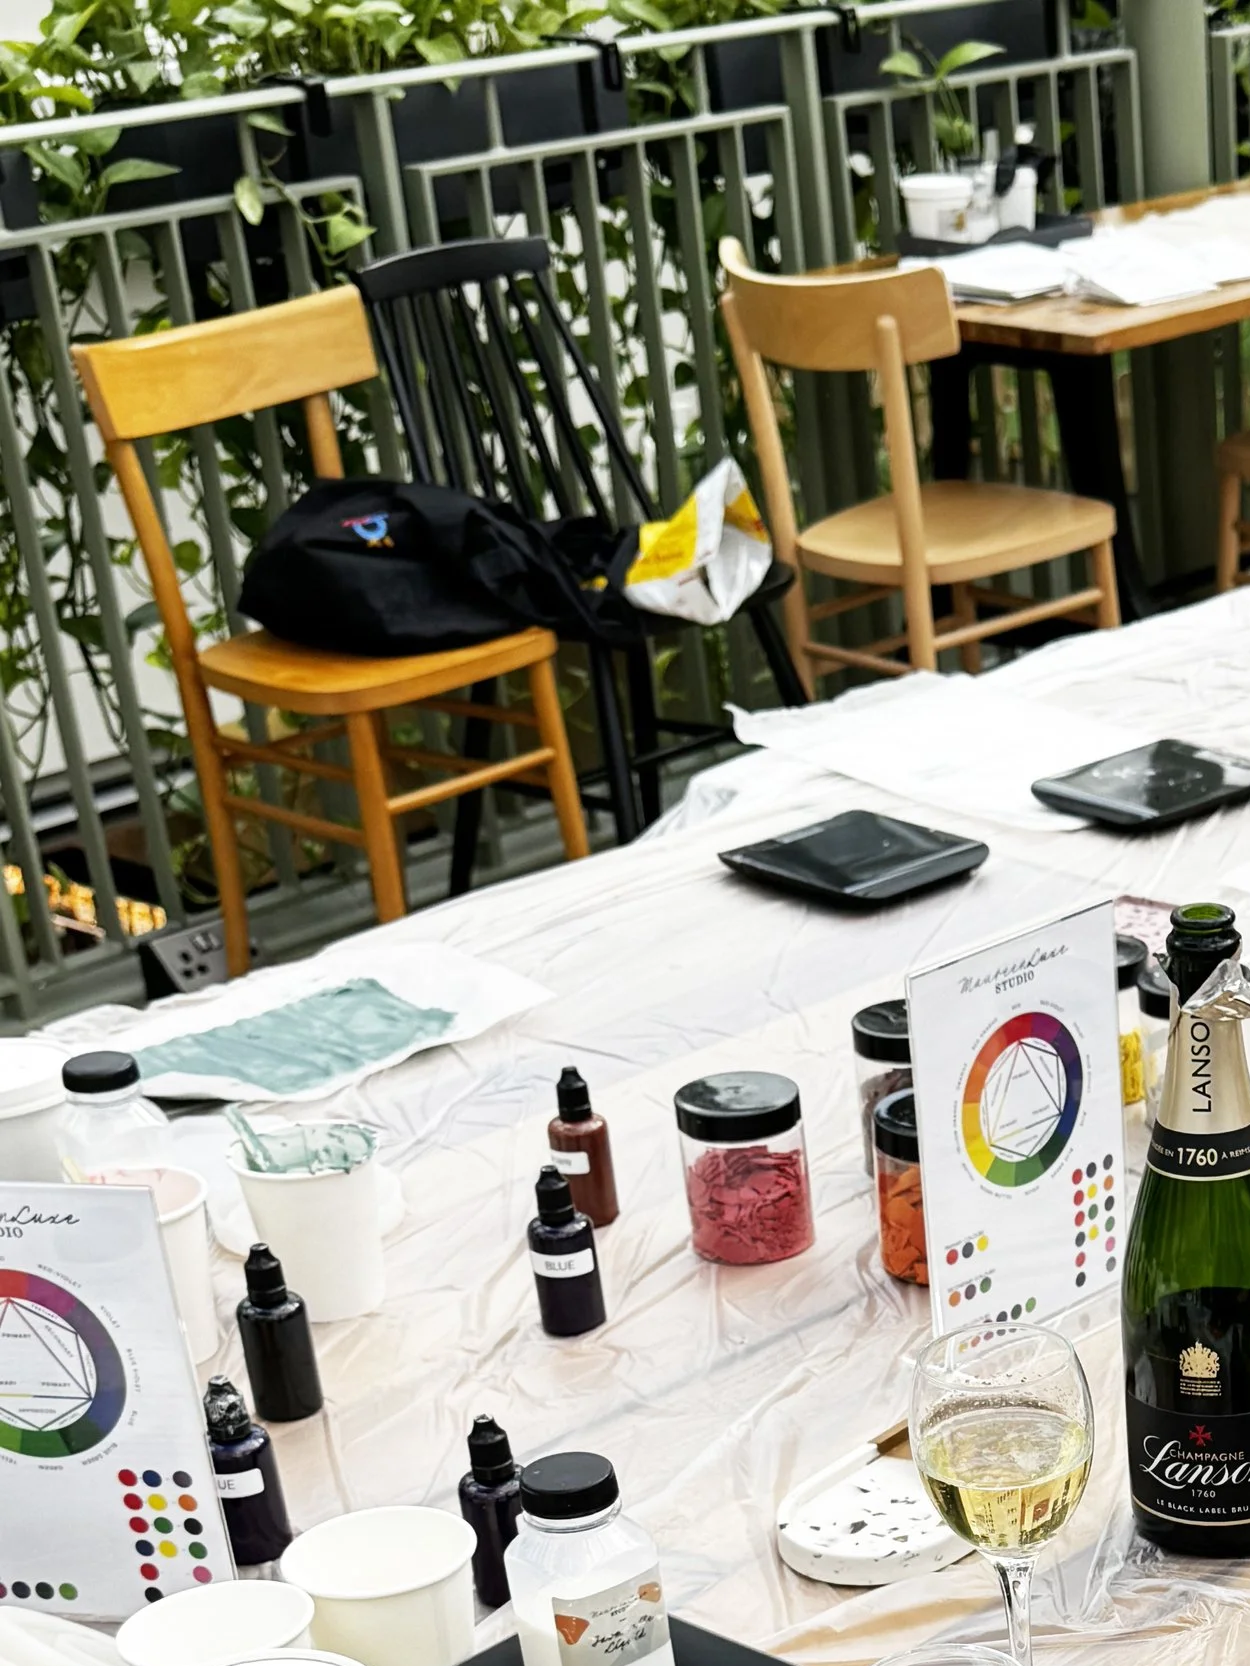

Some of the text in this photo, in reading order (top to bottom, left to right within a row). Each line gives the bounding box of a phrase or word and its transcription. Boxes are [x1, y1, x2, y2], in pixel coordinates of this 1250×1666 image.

[995, 970, 1035, 994] STUDIO
[1190, 1014, 1212, 1112] LANSO
[1177, 1147, 1218, 1166] 1760
[544, 1260, 576, 1271] BLUE
[1169, 1448, 1245, 1462] CHAMPAGNE
[217, 1479, 236, 1491] UE
[1191, 1489, 1216, 1499] 1760
[1156, 1498, 1165, 1506] LE
[1167, 1501, 1195, 1513] BLACK
[1199, 1506, 1227, 1514] LABEL
